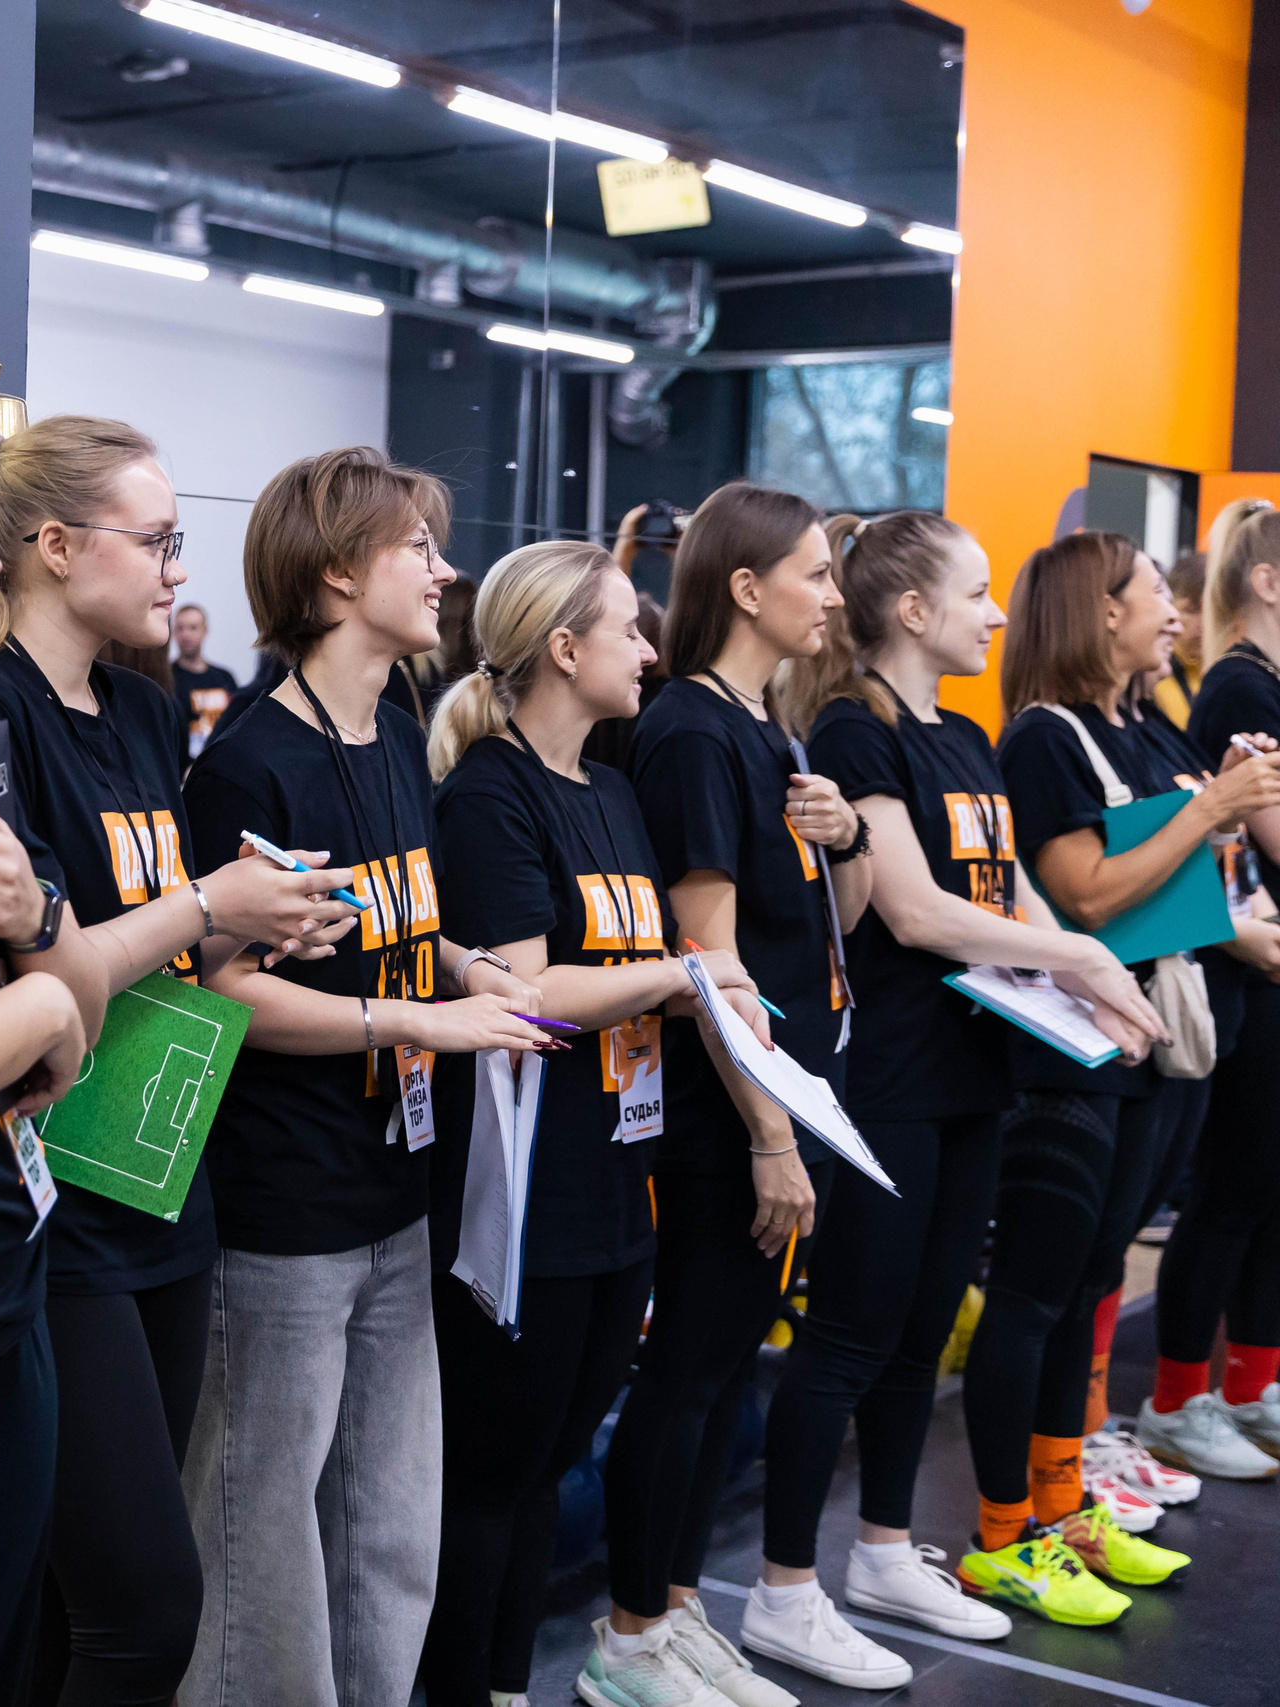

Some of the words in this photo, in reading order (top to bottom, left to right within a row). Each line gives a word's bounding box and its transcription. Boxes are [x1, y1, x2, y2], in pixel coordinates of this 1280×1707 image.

[404, 1069, 425, 1091] ОРГА
[407, 1087, 428, 1110] НИЗА
[409, 1107, 424, 1128] ТОР
[624, 1099, 660, 1123] СУДЬЯ
